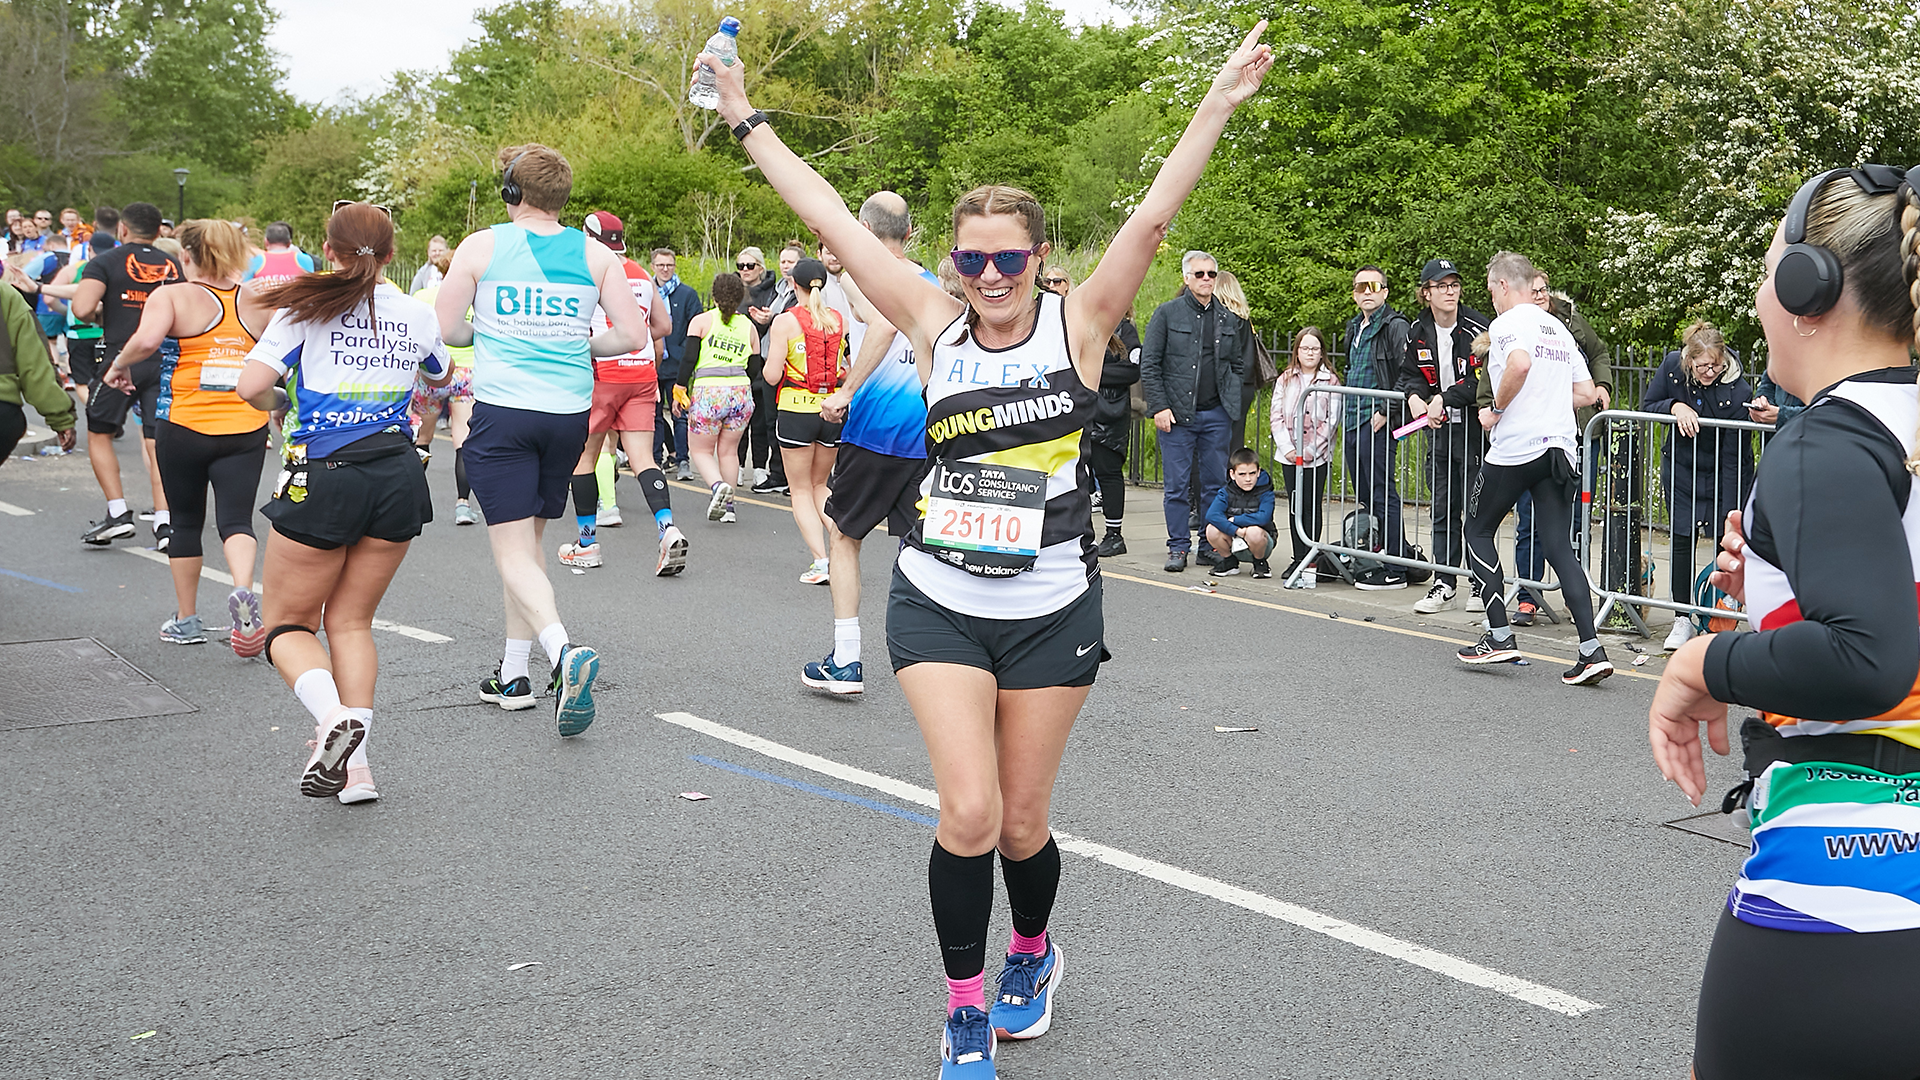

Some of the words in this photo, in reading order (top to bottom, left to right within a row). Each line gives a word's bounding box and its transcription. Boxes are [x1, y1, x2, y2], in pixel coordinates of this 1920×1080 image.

[496, 285, 580, 317] Bliss
[340, 313, 408, 337] Curing
[497, 318, 510, 326] for
[513, 318, 546, 327] babies
[548, 319, 570, 327] born
[330, 331, 420, 354] Paralysis
[330, 350, 416, 371] Together
[947, 359, 1051, 388] ALEX
[793, 396, 827, 405] LIZ
[927, 391, 1075, 445] YOUNGMINDS
[938, 465, 977, 495] tcs
[979, 469, 1006, 480] TATA
[976, 488, 1017, 500] SERVICES
[978, 479, 1041, 494] CONSULTANCY
[940, 509, 1022, 544] 25110
[965, 563, 984, 574] new
